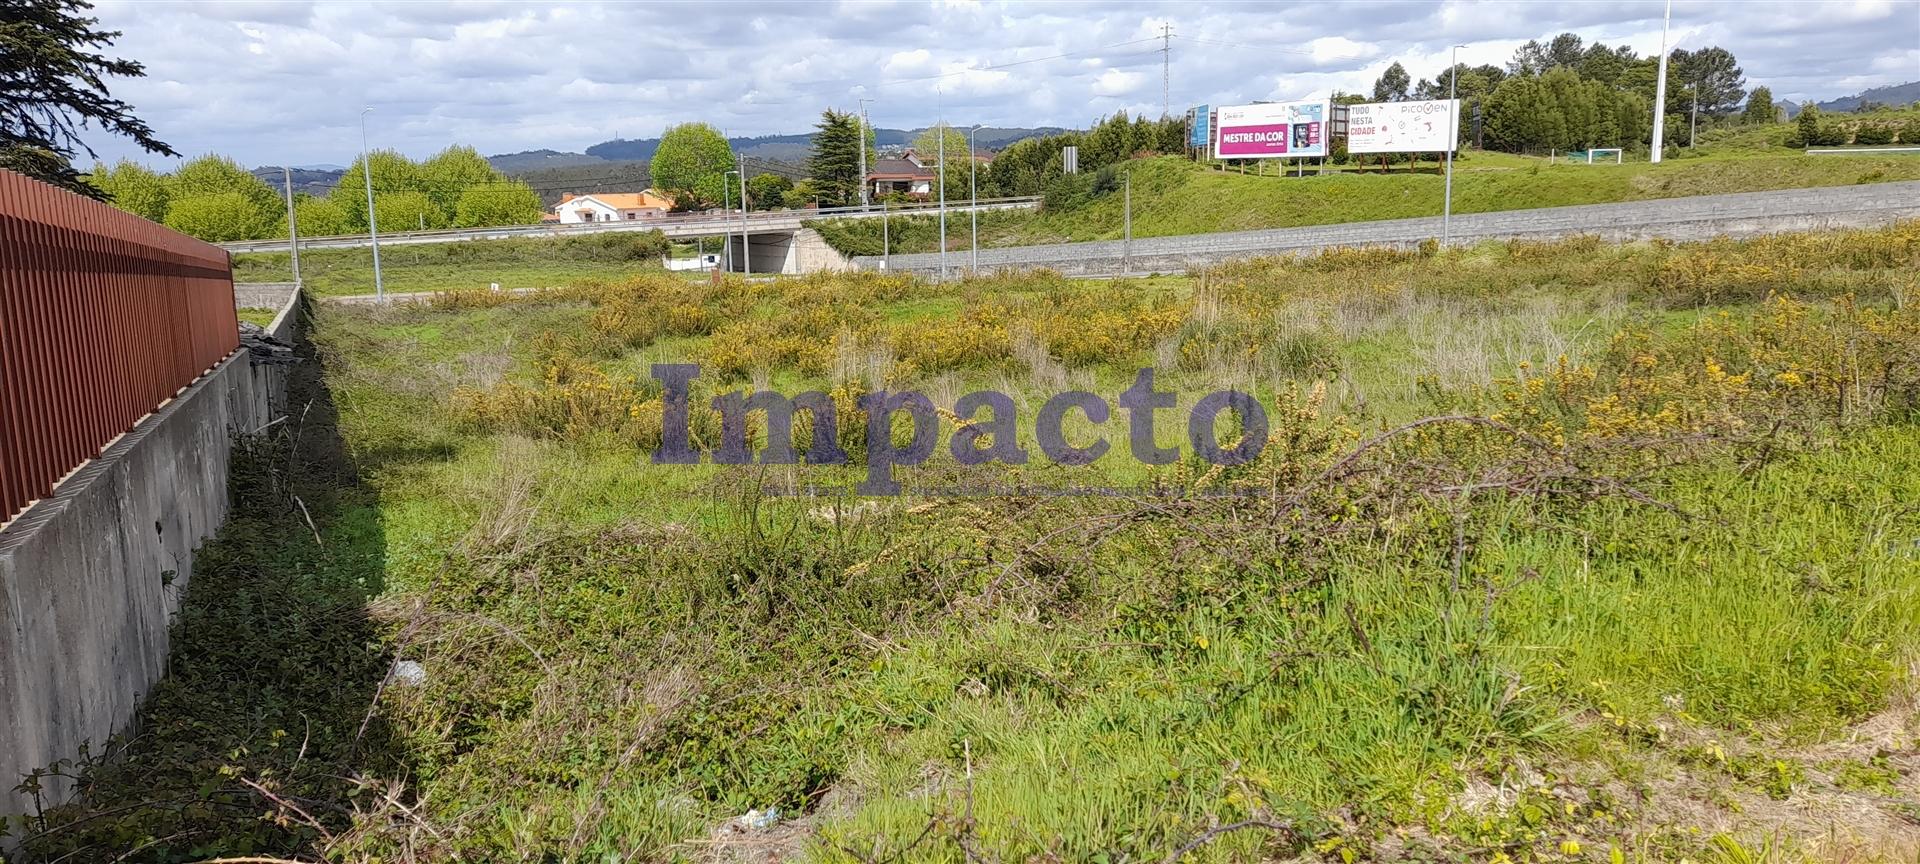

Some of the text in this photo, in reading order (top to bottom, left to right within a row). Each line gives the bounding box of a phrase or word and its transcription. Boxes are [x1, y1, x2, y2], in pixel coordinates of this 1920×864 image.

[1351, 106, 1370, 115] TUDO
[1351, 117, 1373, 125] NESTA
[1350, 127, 1376, 136] CIDADE
[1223, 131, 1284, 144] MESTRE DA COR
